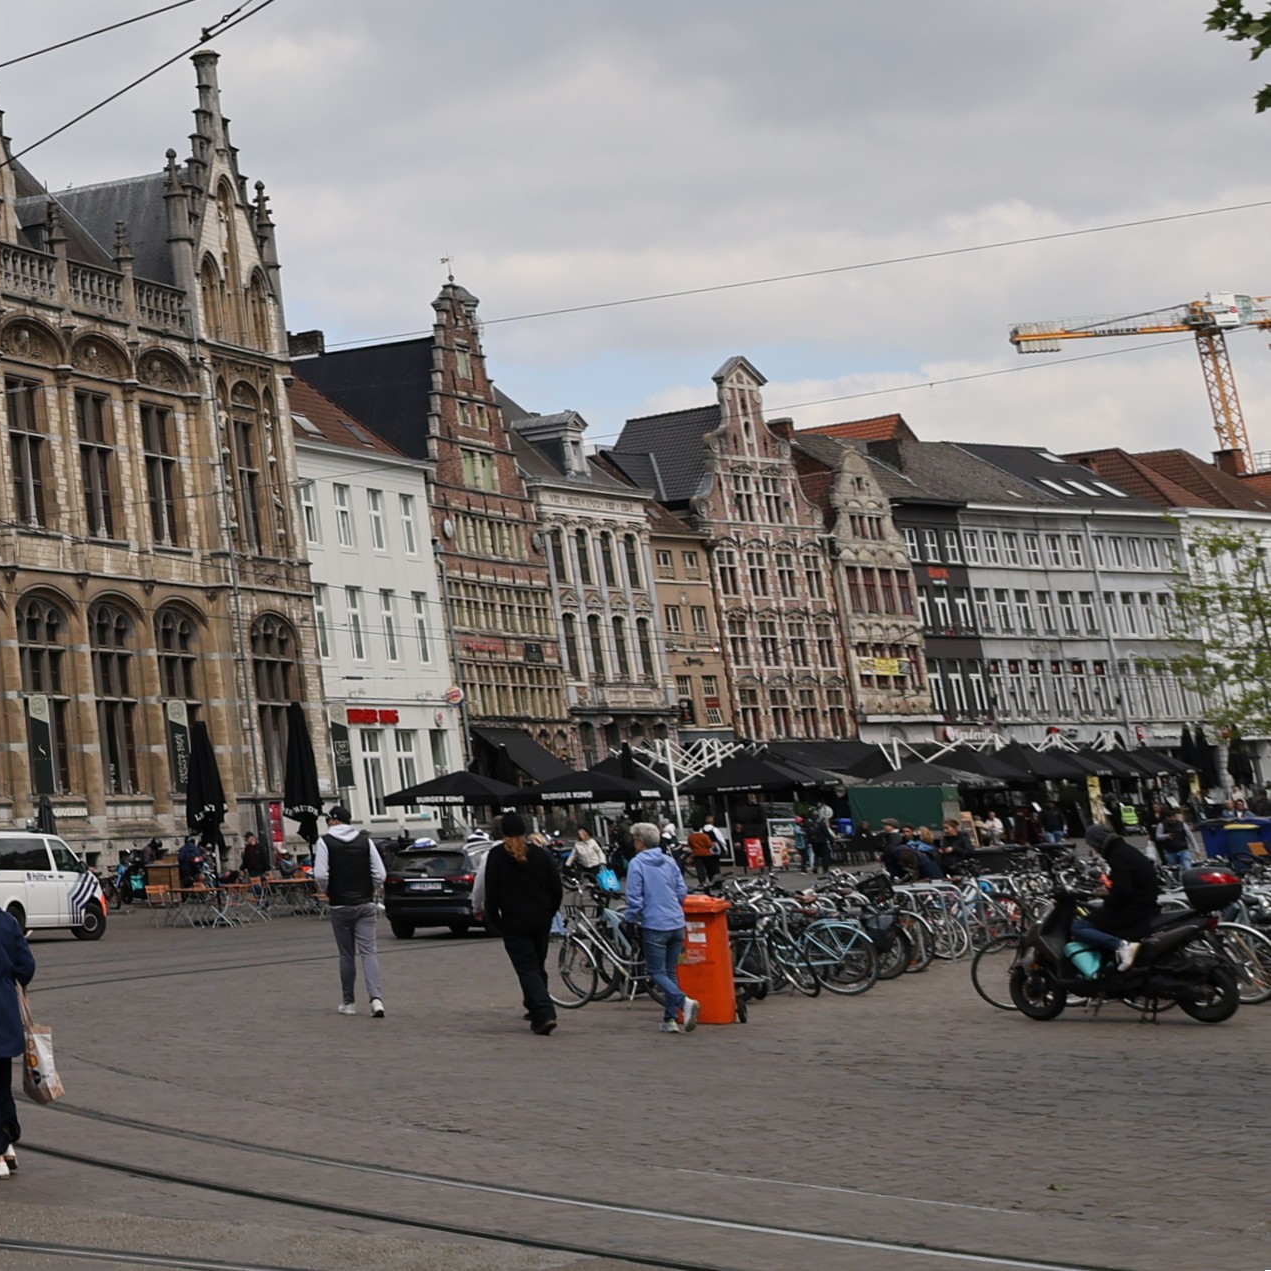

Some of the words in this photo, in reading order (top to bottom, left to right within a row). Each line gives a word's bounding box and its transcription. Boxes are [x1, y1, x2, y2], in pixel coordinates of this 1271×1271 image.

[445, 795, 464, 803] KING
[541, 792, 572, 800] BURGER
[573, 791, 593, 799] KING
